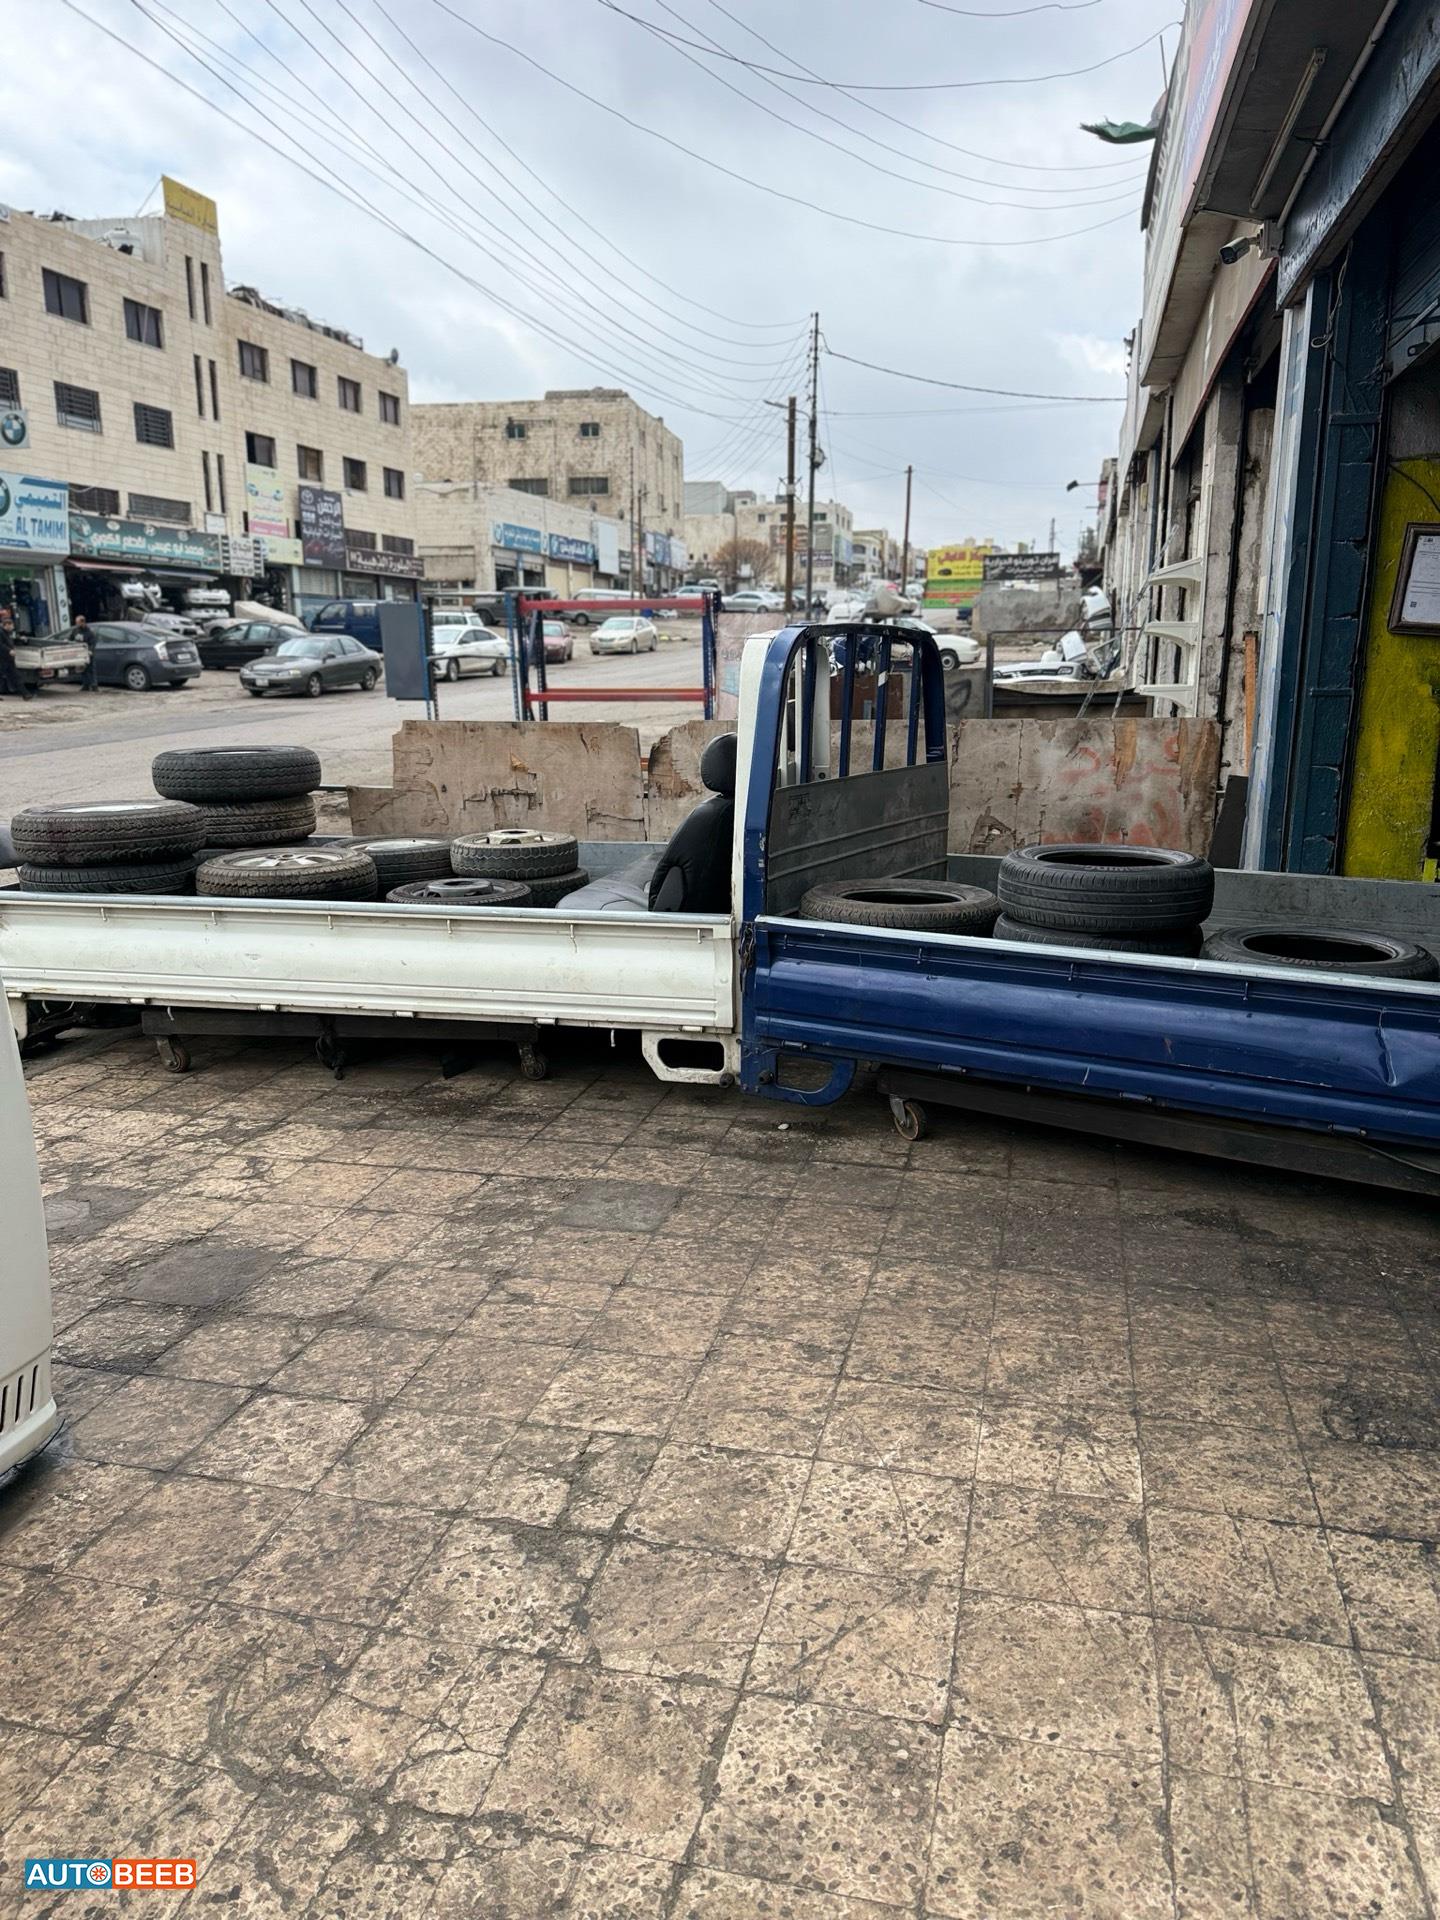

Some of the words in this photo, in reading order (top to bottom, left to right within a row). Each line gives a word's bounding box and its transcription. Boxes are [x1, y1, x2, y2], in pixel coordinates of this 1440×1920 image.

[14, 492, 66, 513] التميمي
[16, 516, 28, 535] AL
[30, 518, 66, 539] TAMIMI
